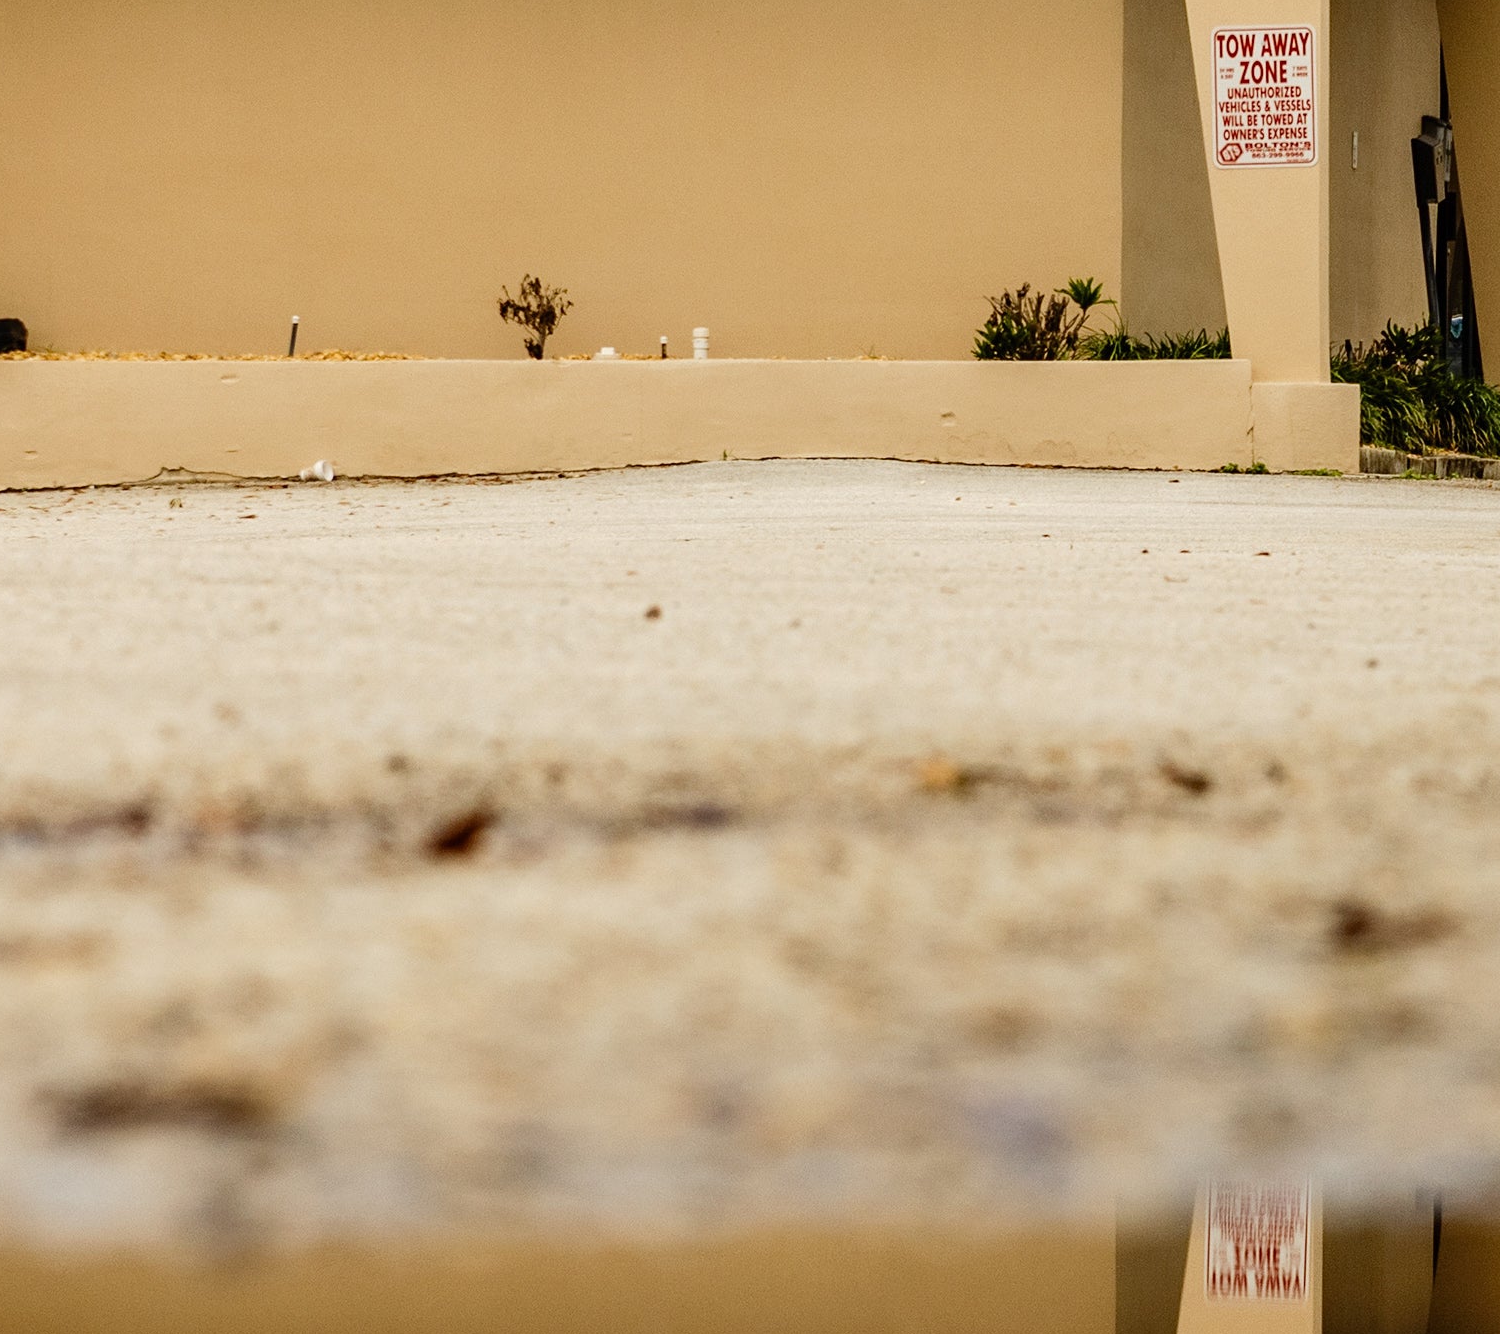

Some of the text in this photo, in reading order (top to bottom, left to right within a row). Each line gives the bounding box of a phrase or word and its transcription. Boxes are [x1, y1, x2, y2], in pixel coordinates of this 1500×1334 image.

[1217, 32, 1309, 58] TOW AWAY
[1239, 60, 1288, 84] ZONE
[1227, 86, 1302, 99] UNAUTHORIZED
[1219, 99, 1311, 113] VEHICLES & VESSELS
[1222, 113, 1307, 126] WILL BE TOWED AT
[1223, 127, 1307, 140] OWNER'S EXPENSE
[1245, 141, 1311, 149] BOLTON'S
